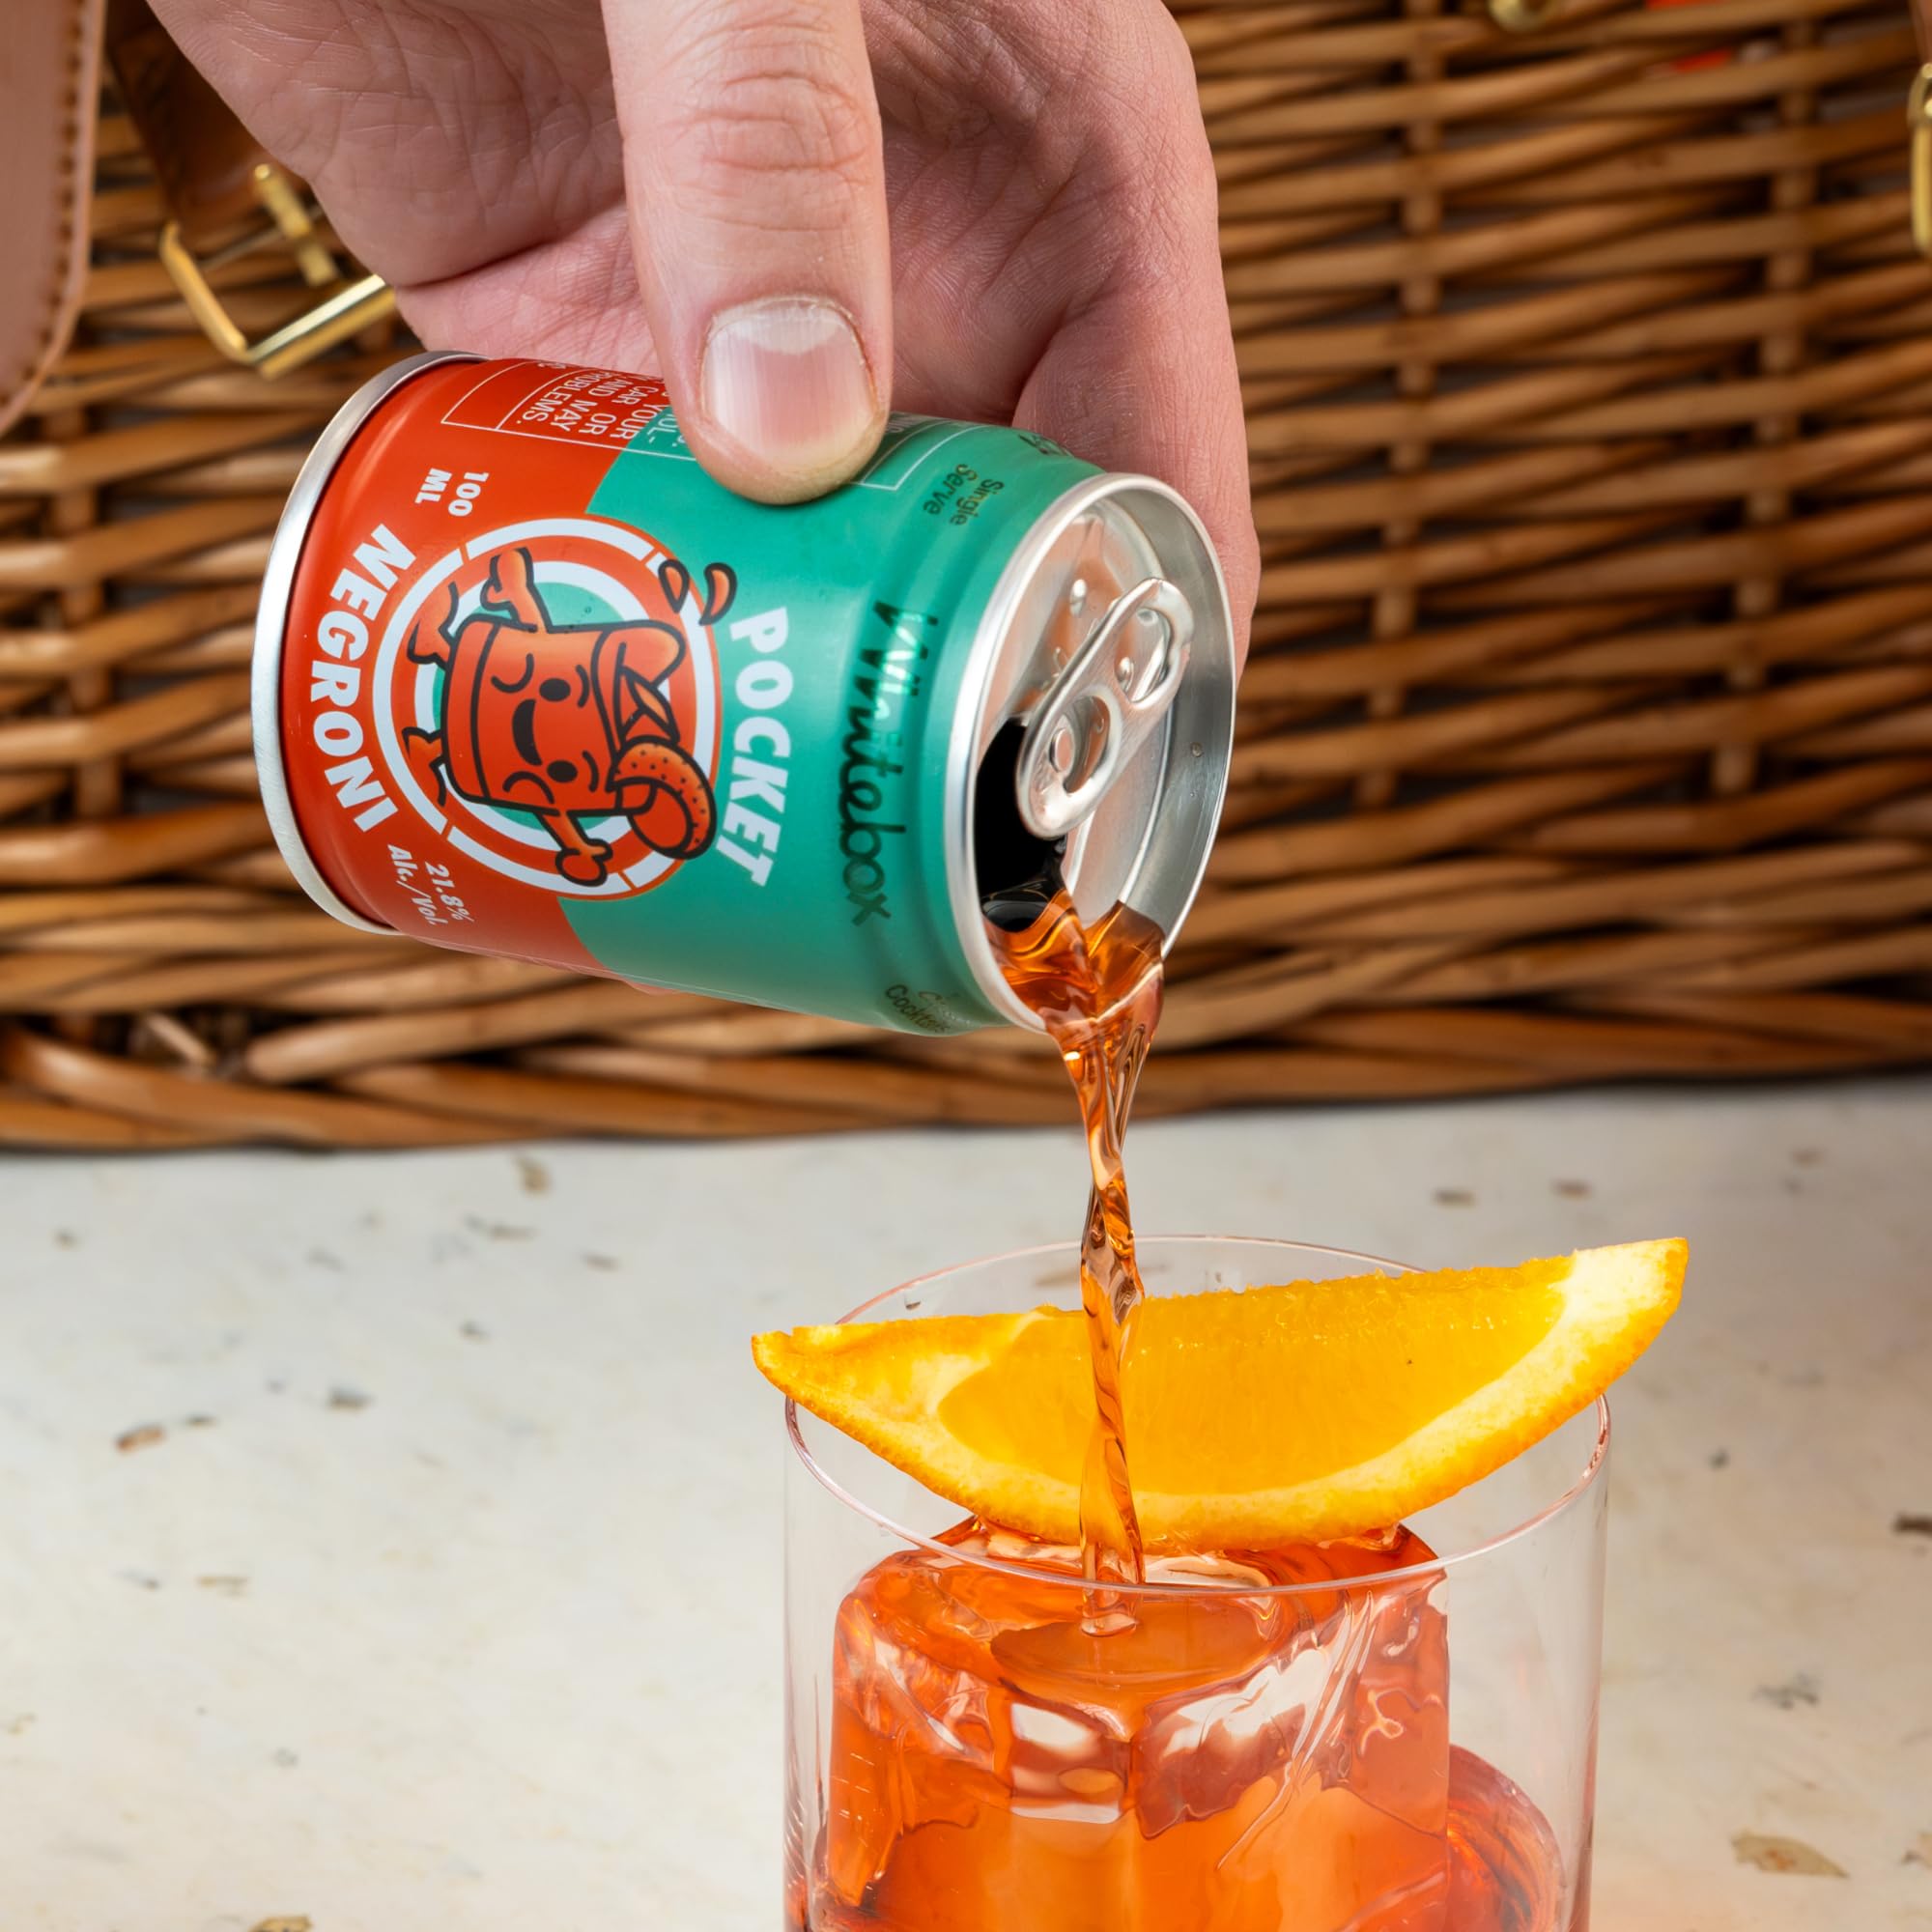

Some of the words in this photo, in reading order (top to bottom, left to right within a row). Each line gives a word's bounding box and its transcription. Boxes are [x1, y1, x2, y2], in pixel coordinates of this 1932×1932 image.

[587, 378, 634, 397] AND
[611, 385, 659, 405] CAR
[550, 399, 598, 432] MAY
[578, 412, 617, 435] OR
[610, 403, 670, 440] YOUR
[414, 468, 452, 504] ML
[448, 471, 489, 517] 100
[923, 463, 978, 515] Serve
[950, 478, 1005, 526] Single
[310, 523, 417, 833] NEGRONI
[715, 606, 794, 888] POCKET
[838, 600, 939, 927] Whitebox
[425, 861, 474, 922] 21.8%
